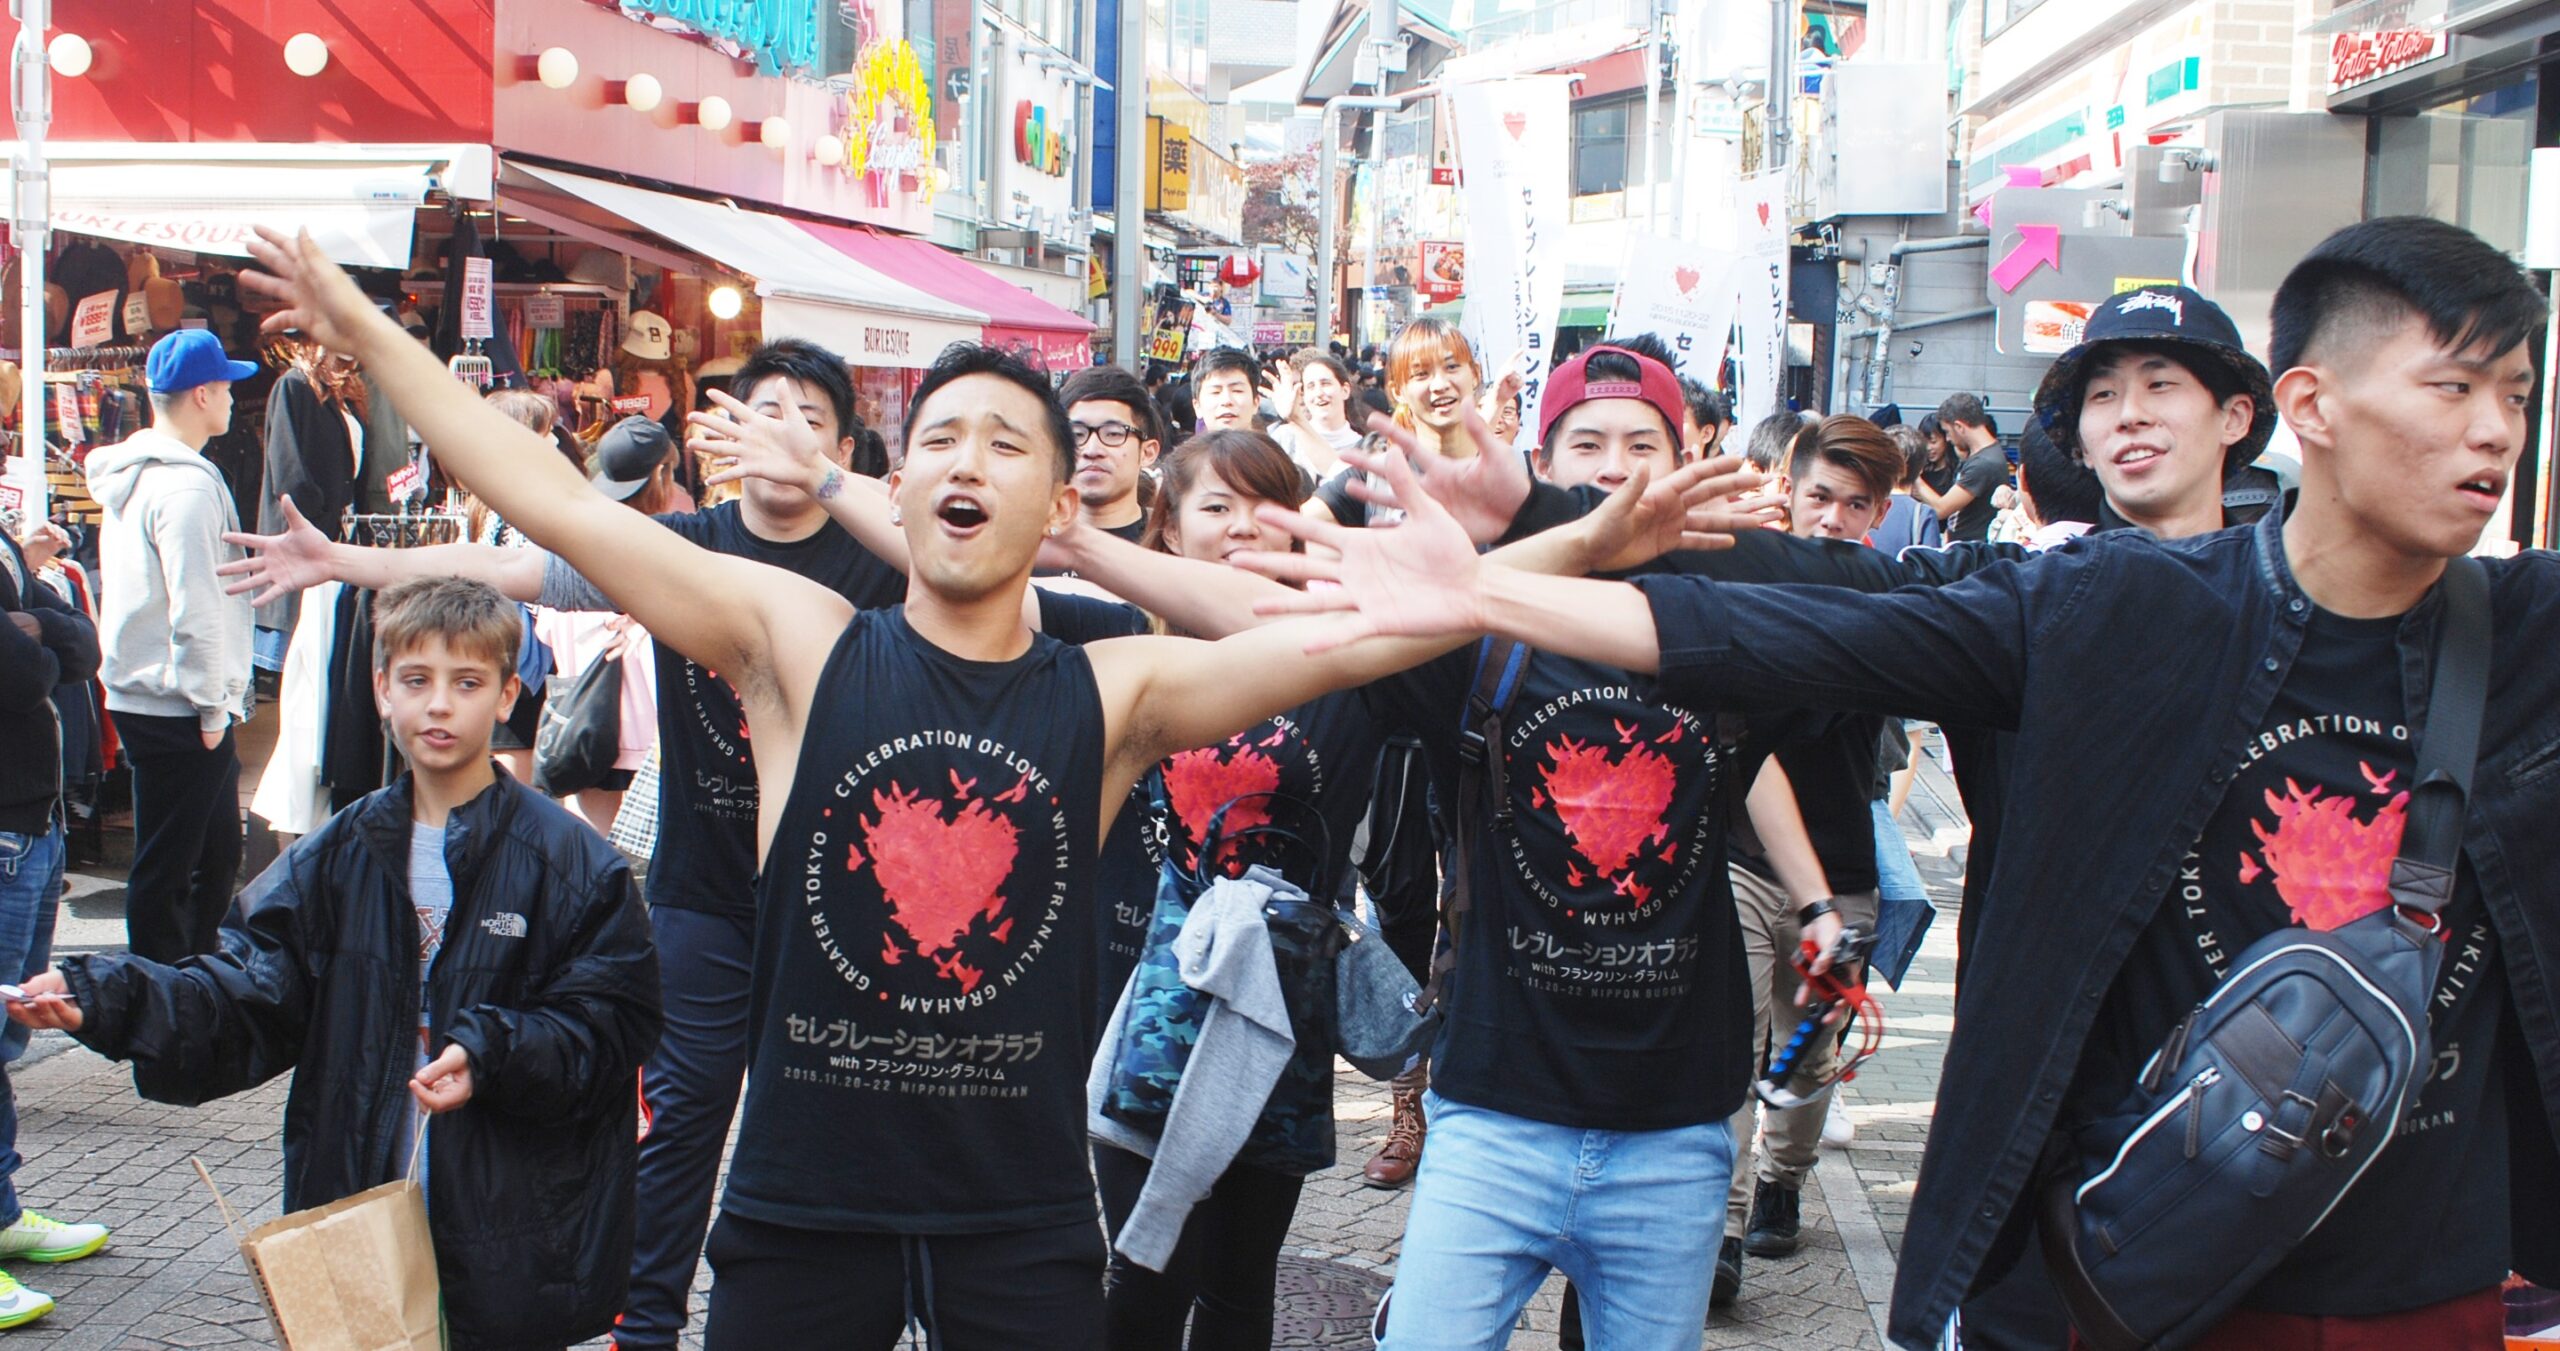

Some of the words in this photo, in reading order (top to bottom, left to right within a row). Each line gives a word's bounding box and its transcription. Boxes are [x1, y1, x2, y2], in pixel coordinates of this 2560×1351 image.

[1164, 138, 1187, 174] 薬
[1522, 185, 1542, 408] セレブレーションオ
[863, 326, 911, 359] BURLESQUE
[1152, 337, 1179, 359] 999
[685, 657, 698, 696] TOKY
[1510, 685, 1629, 748] CELEBRATION
[834, 729, 972, 798] CELEBRATION
[978, 738, 1004, 757] OF
[1268, 714, 1300, 739] OVE
[1306, 748, 1323, 794] WITH
[1005, 750, 1051, 795] LOVE
[713, 797, 735, 808] with
[1051, 810, 1069, 870] WITH
[806, 831, 828, 905] TOKYO
[1510, 836, 1559, 908] GREATER
[2178, 847, 2207, 920] TOKY
[481, 919, 513, 929] NORTH
[496, 911, 514, 921] THE
[1583, 898, 1663, 926] GRAHAM
[488, 927, 513, 937] FACE
[1003, 880, 1068, 987] FRANKLIN
[811, 912, 870, 991] GREATER
[1531, 961, 1556, 976] with
[1559, 965, 1681, 983] フランクリン・グラハム
[900, 984, 998, 1014] GRAHAM
[1590, 987, 1640, 1000] NIPPON
[786, 1012, 1044, 1063] セレブレーションオブラブ
[829, 1054, 860, 1071] with
[864, 1057, 1006, 1081] フランクリン・グラハム
[900, 1080, 957, 1097] NIPPON
[960, 1083, 1029, 1099] BUDOKAN
